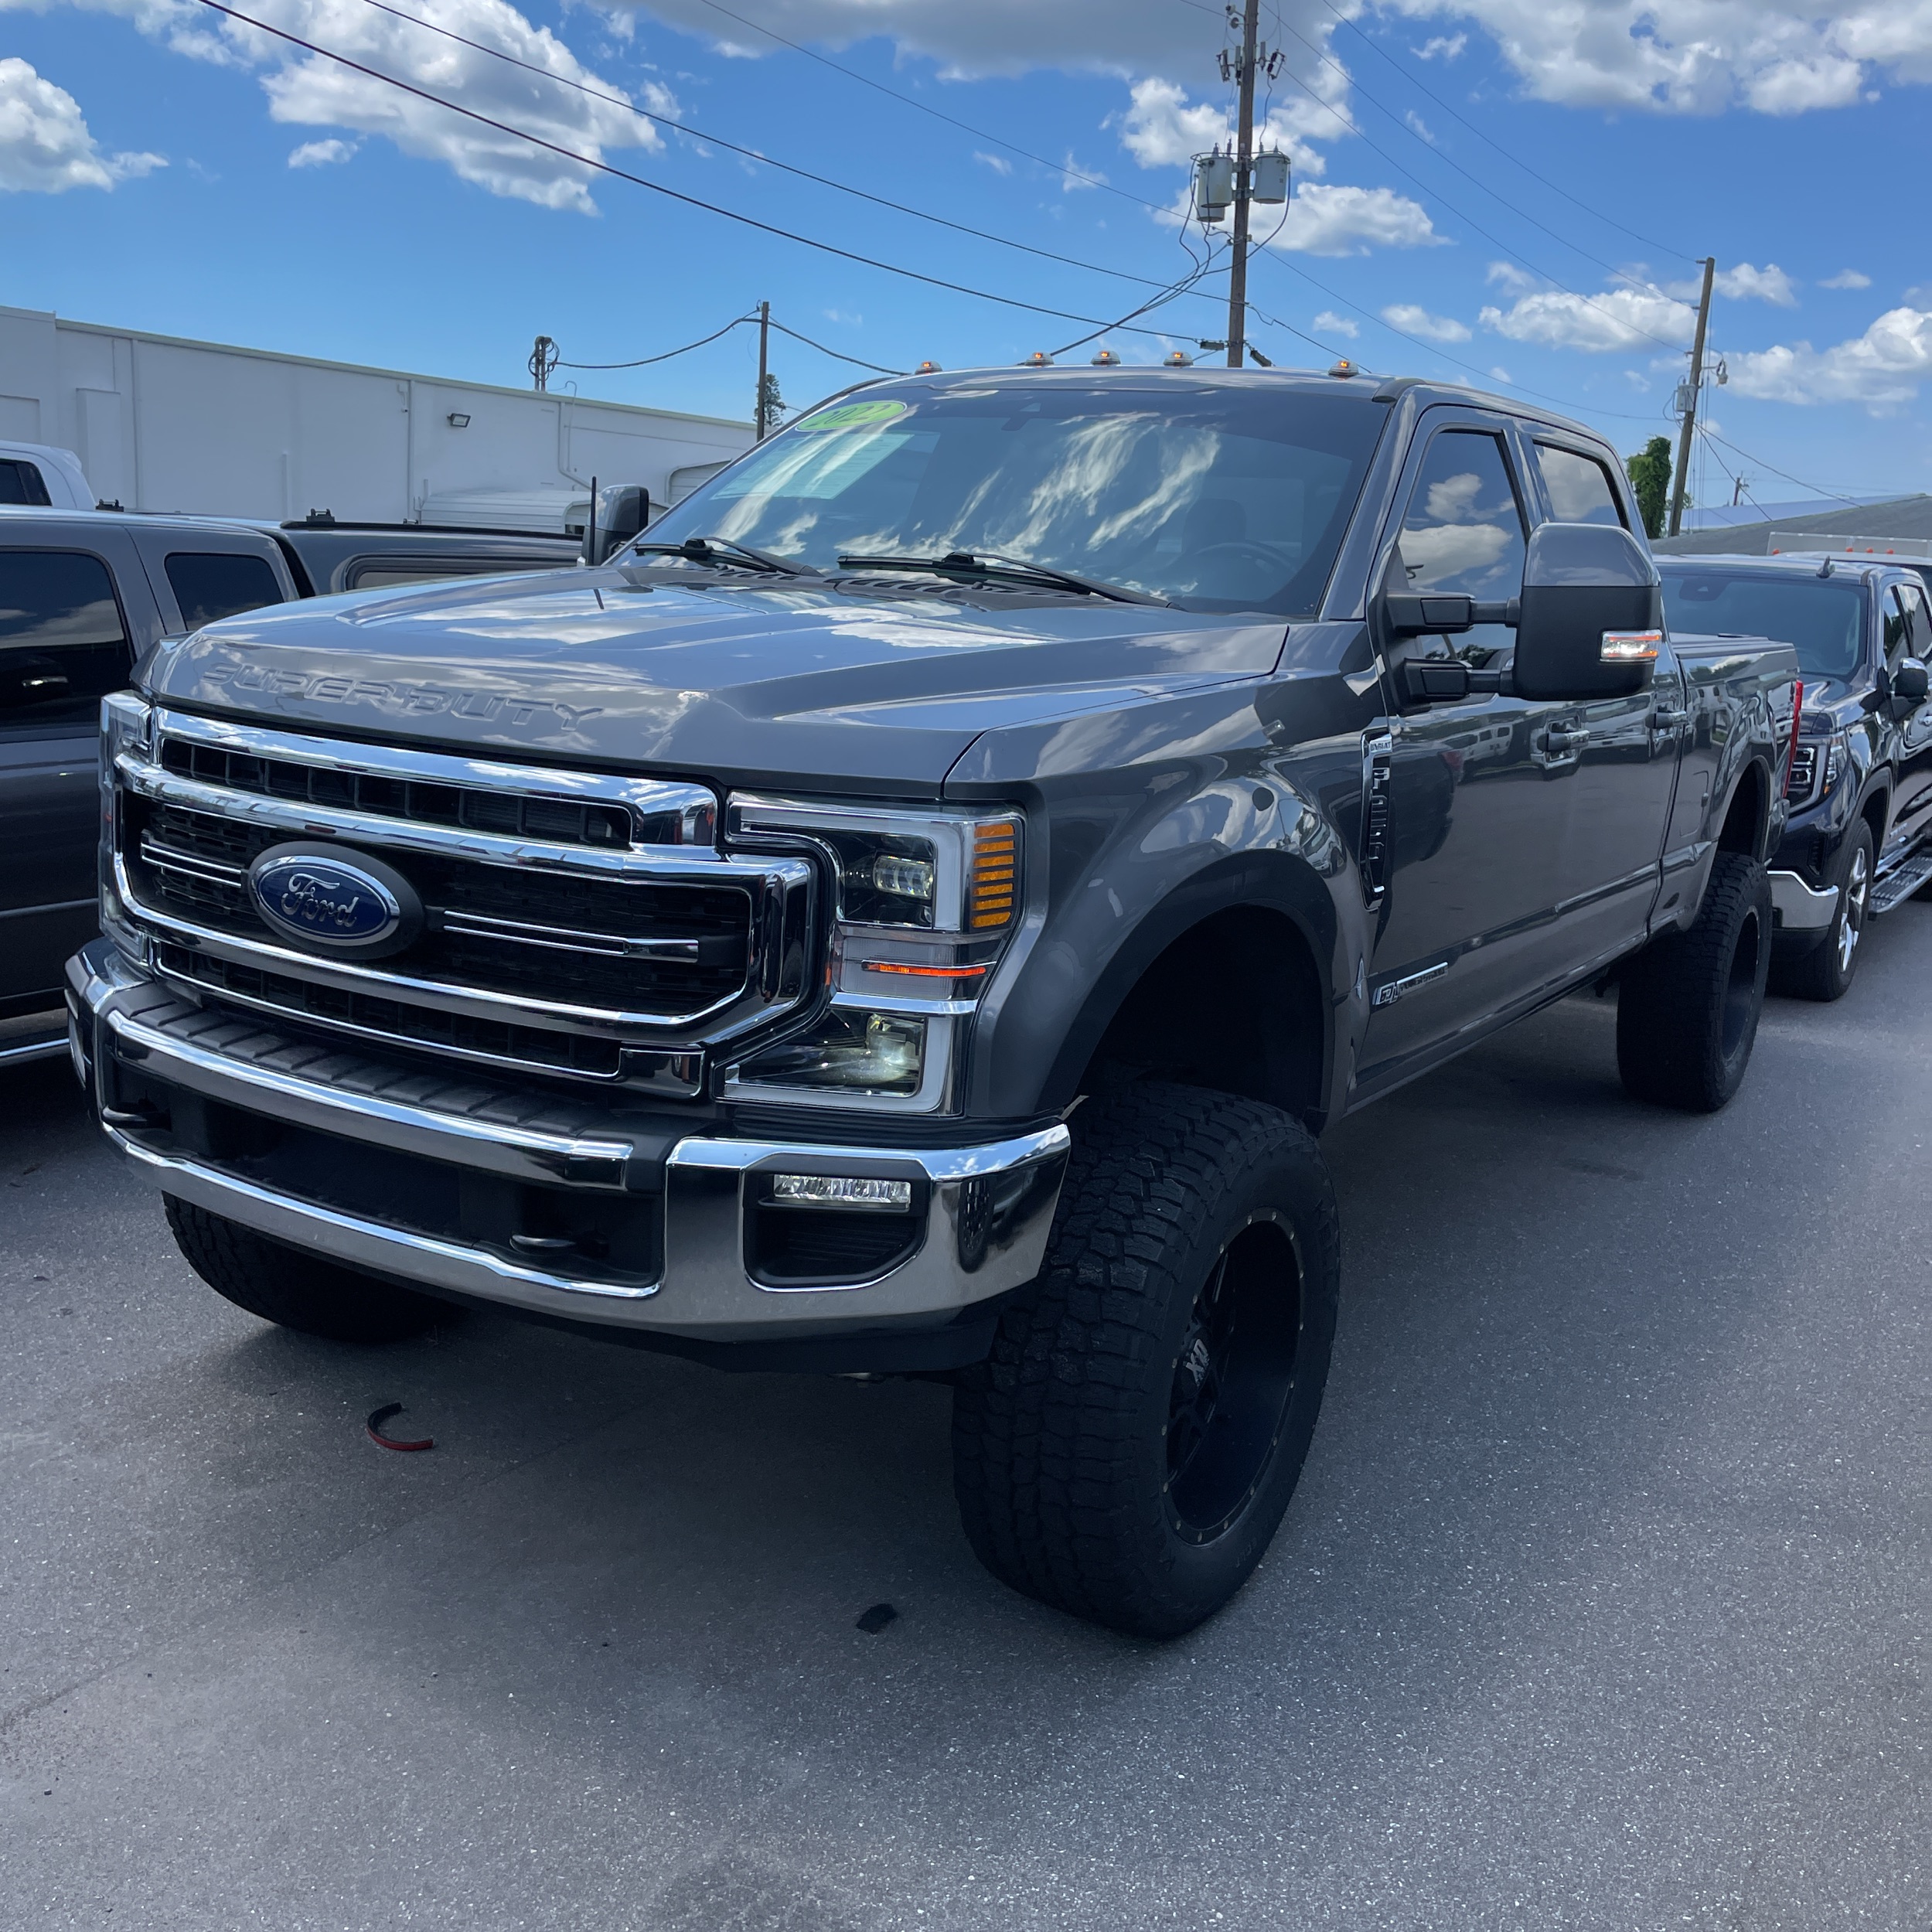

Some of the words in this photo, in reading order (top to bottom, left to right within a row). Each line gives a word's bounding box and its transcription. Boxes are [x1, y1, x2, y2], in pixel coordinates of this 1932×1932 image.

[806, 403, 892, 428] 2022
[203, 660, 396, 707] SUPER
[399, 687, 605, 731] DUTY
[280, 873, 360, 928] Ford
